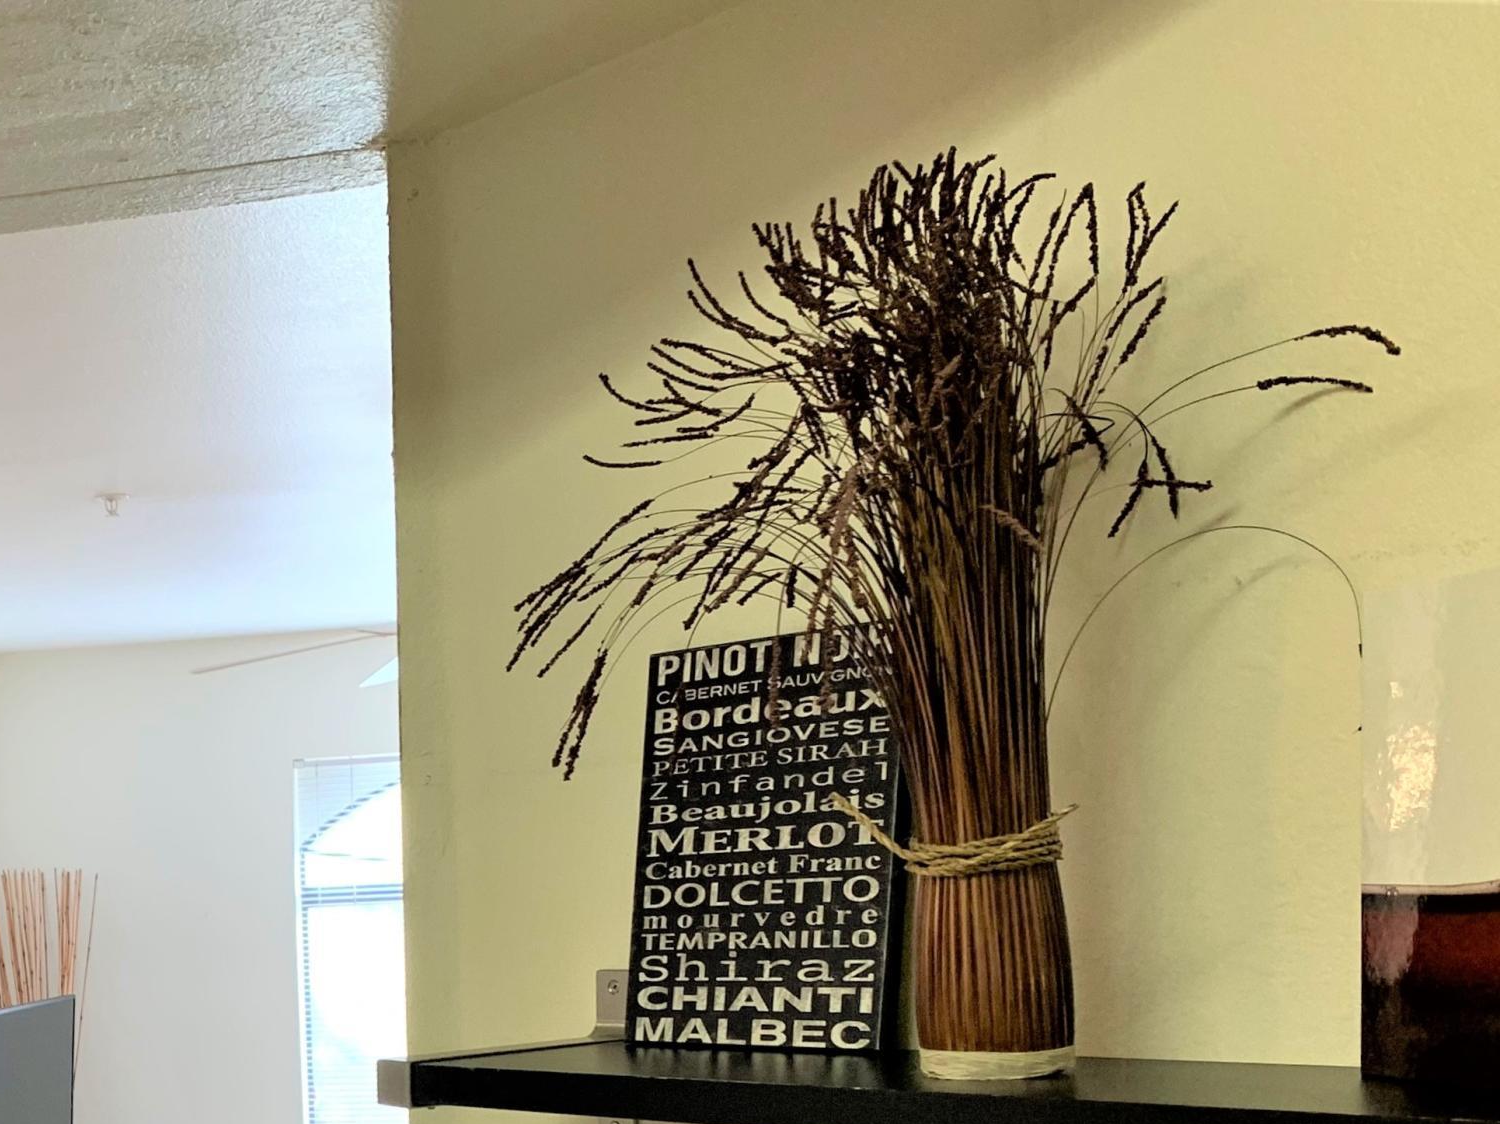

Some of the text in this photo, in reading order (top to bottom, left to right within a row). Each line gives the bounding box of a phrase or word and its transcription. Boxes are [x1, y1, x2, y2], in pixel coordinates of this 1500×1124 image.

[657, 640, 772, 686] PINOT
[653, 688, 887, 735] Bordeaux
[652, 716, 890, 756] SANGIOVESE
[652, 738, 888, 777] PETITE SIRAH
[650, 763, 888, 801] Zinfandel
[648, 788, 885, 825] Beaujolais
[646, 819, 884, 858] MERLOT
[646, 853, 882, 880] Cabernet Franc
[643, 875, 880, 909] DOLCETTO
[643, 905, 878, 930] mourvedre
[641, 928, 877, 952] TEMPRANILLO
[638, 951, 875, 982] Shiraz
[637, 986, 874, 1014] CHIANTI
[634, 1017, 871, 1050] MALBEC
